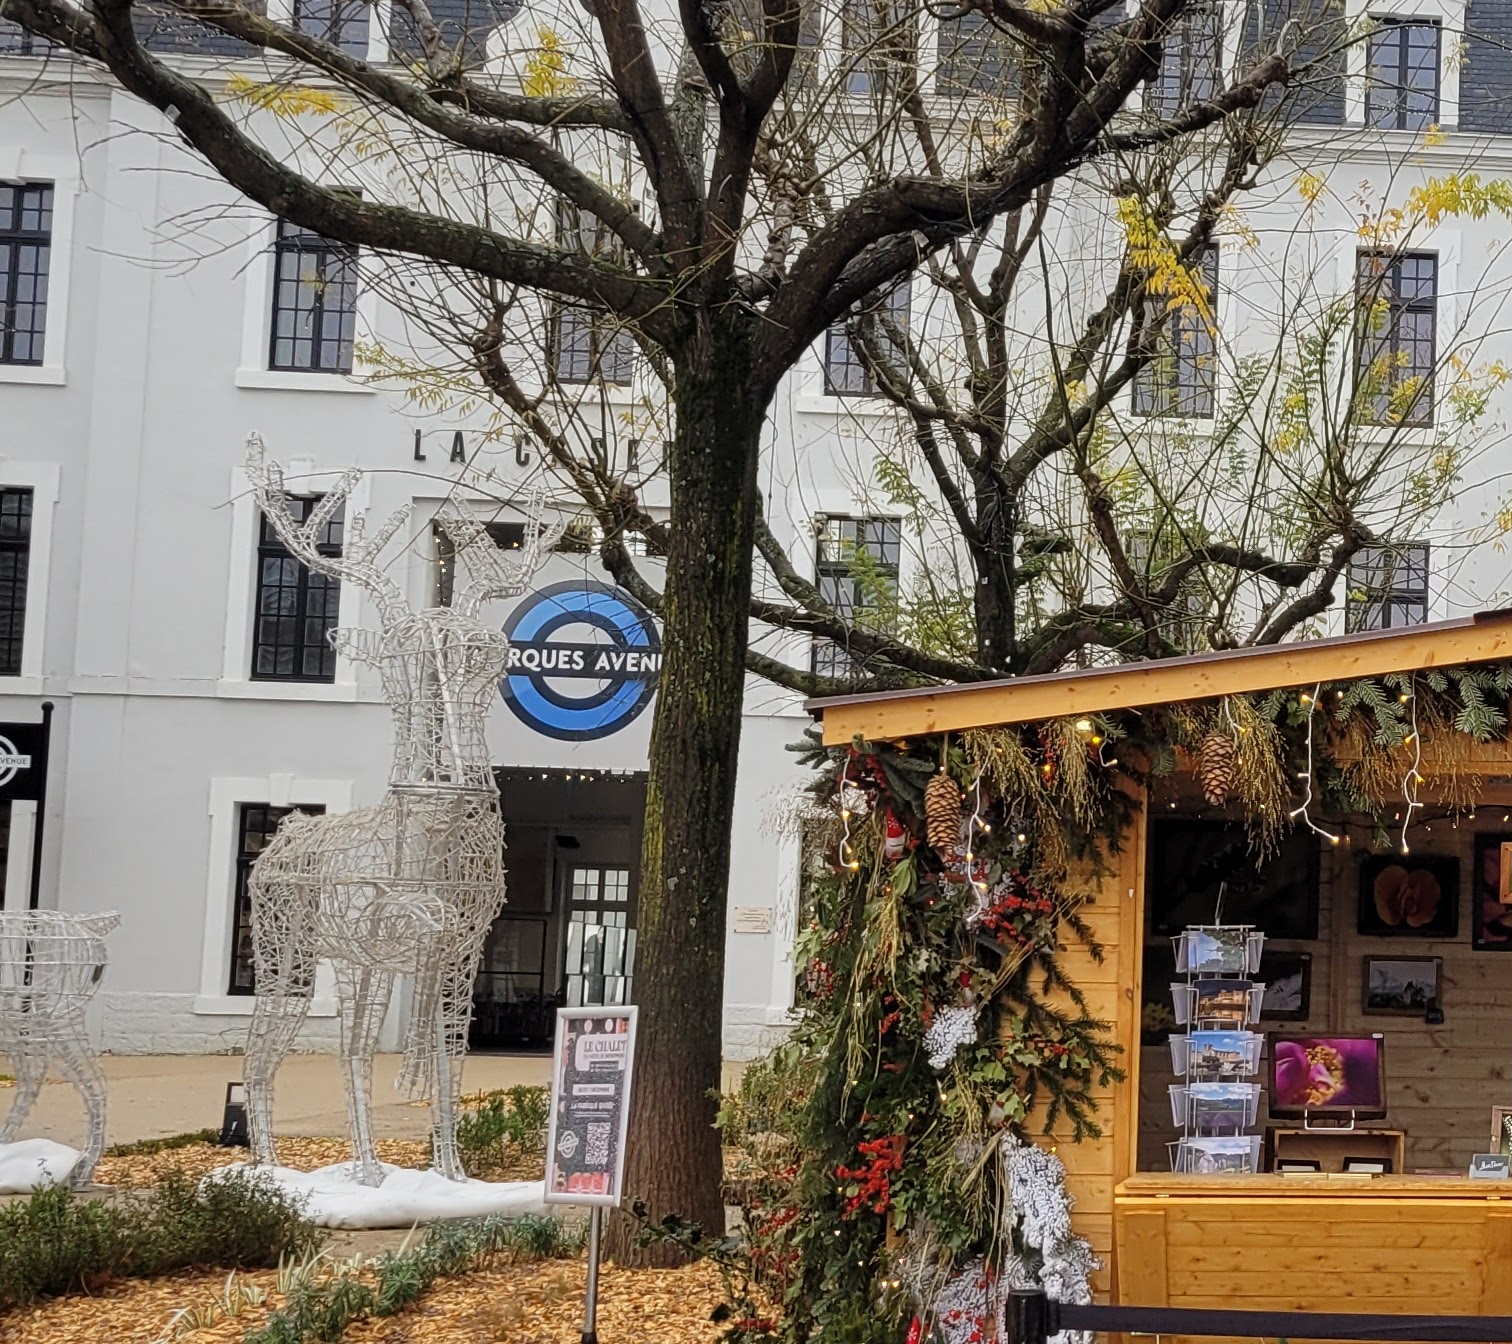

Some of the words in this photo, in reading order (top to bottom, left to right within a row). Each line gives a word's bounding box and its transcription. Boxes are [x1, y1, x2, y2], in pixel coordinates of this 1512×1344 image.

[414, 429, 466, 463] LA
[507, 648, 585, 672] RQUES
[595, 651, 663, 672] AVEN
[584, 1041, 593, 1052] LE
[595, 1040, 626, 1052] CHALET
